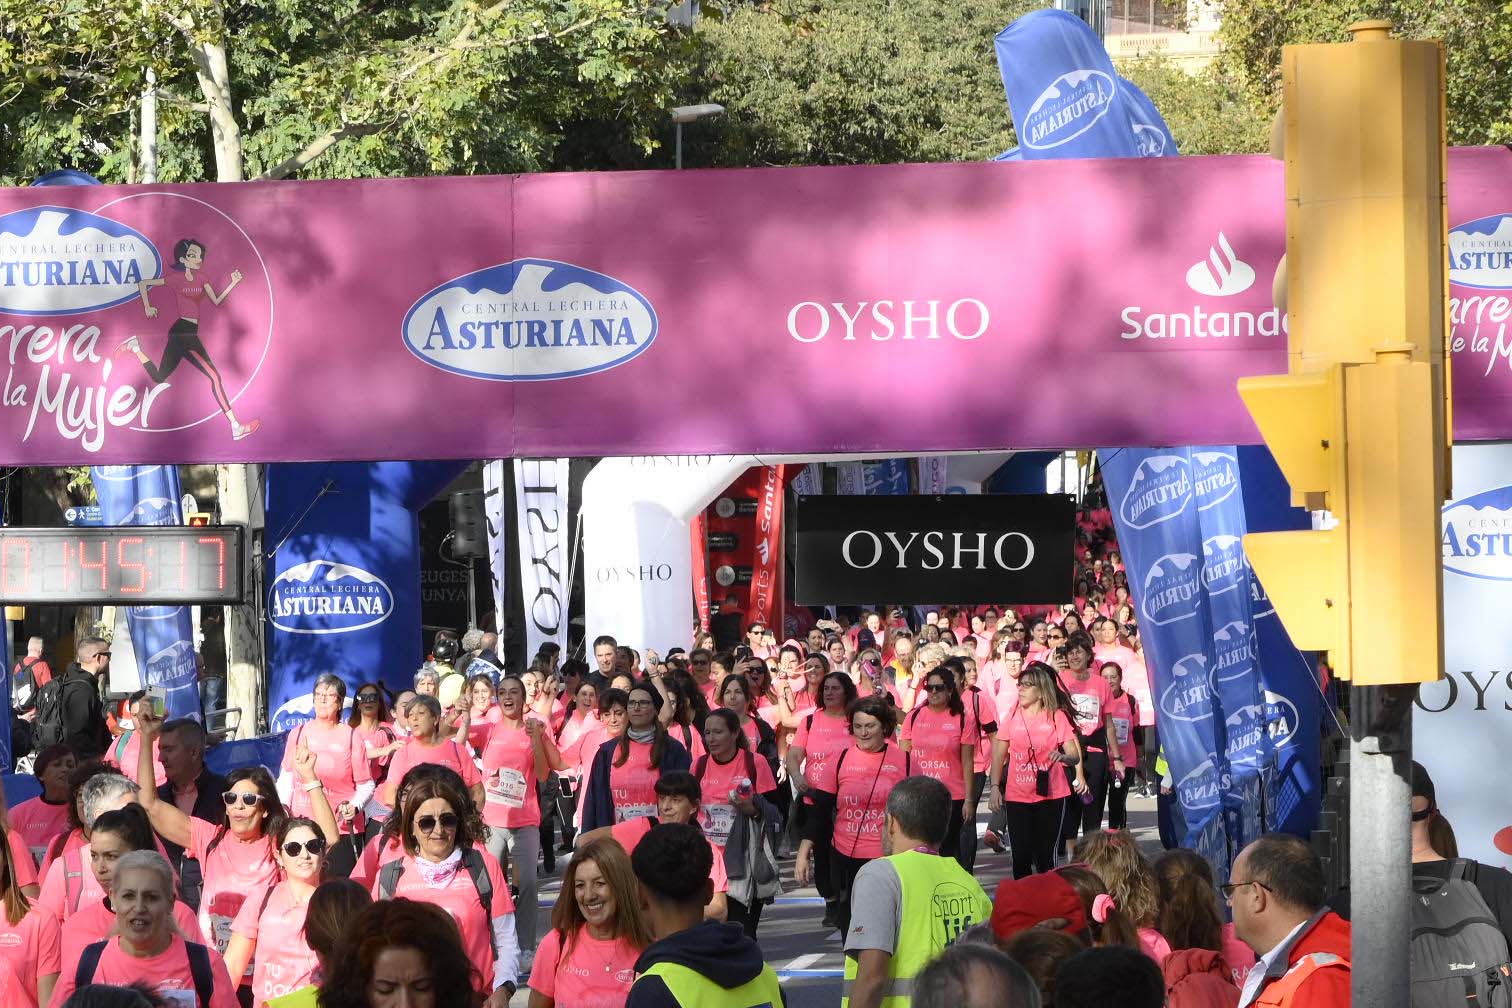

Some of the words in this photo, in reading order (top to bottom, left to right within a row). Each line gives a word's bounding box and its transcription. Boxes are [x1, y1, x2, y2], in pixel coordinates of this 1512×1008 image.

[65, 242, 137, 253] LECHERA
[461, 301, 539, 314] CENTRAL
[546, 299, 629, 312] LECHERA
[422, 306, 638, 350] ASTURIANA
[787, 298, 989, 343] OYSHO
[1120, 306, 1288, 340] Santand
[1470, 324, 1489, 353] la
[3, 367, 27, 407] la
[22, 358, 172, 452] Mujer
[842, 529, 1036, 571] OYSHO
[596, 563, 673, 584] OYSHO
[284, 585, 328, 595] CENTRAL
[332, 585, 381, 595] LECHERA
[272, 590, 385, 618] ASTURIANA
[920, 760, 950, 769] ORSAL
[614, 789, 627, 799] TU
[845, 796, 859, 806] TU
[846, 809, 889, 820] DORSA
[933, 894, 974, 921] Sport
[943, 915, 972, 948] Lif
[264, 962, 281, 977] TU
